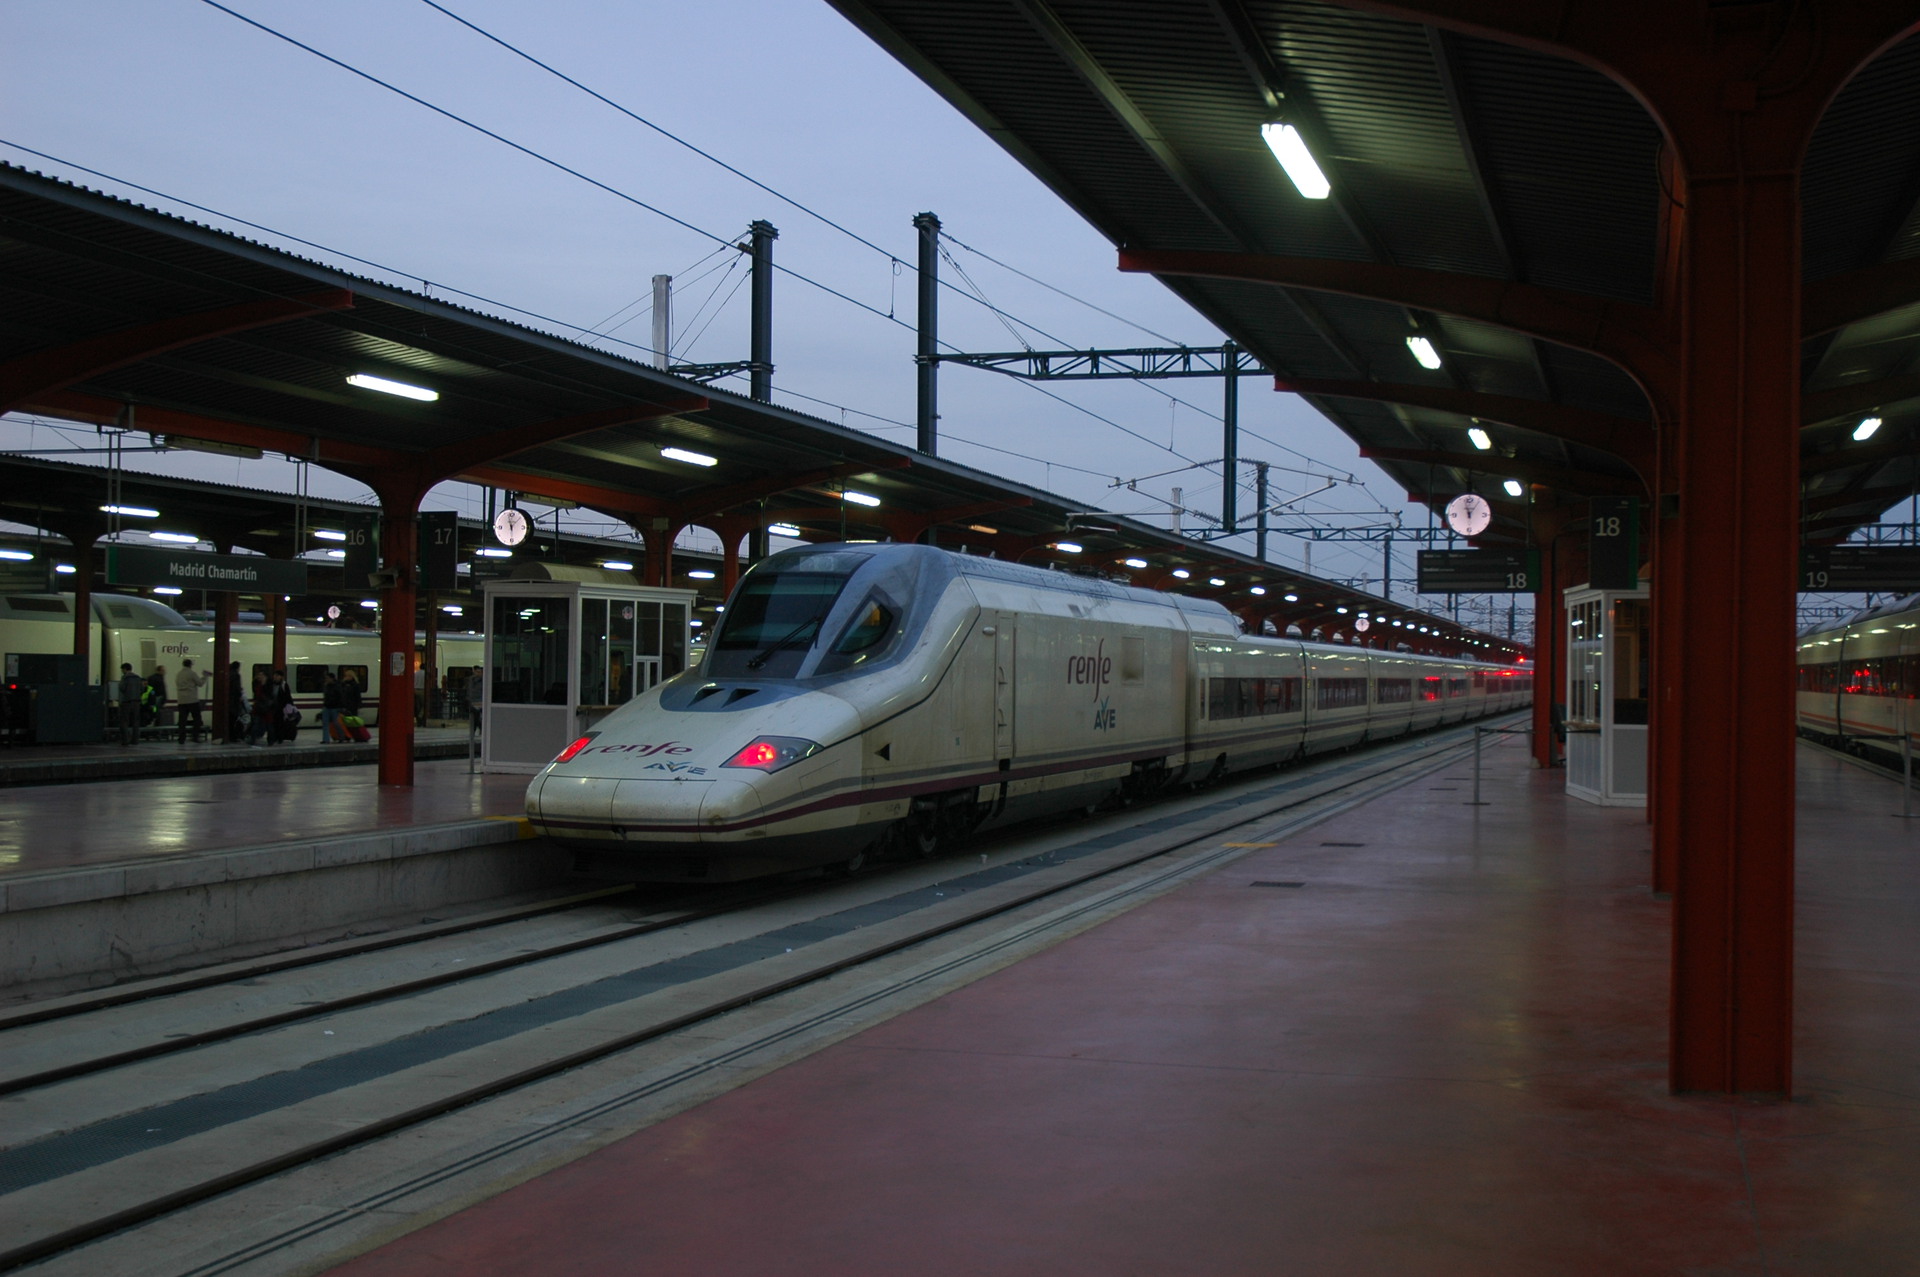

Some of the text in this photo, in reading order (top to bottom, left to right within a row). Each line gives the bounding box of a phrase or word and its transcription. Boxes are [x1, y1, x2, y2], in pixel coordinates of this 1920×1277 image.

[1595, 516, 1620, 537] 18
[348, 528, 365, 546] 16
[434, 528, 452, 545] 17
[170, 562, 258, 581] Madrid Chamartín
[1806, 571, 1828, 588] 19
[1506, 573, 1527, 590] 18
[161, 641, 189, 656] renfe
[1067, 638, 1112, 703] renfe
[1093, 695, 1116, 733] AVE
[580, 741, 693, 758] renfe
[643, 760, 708, 776] AVE
